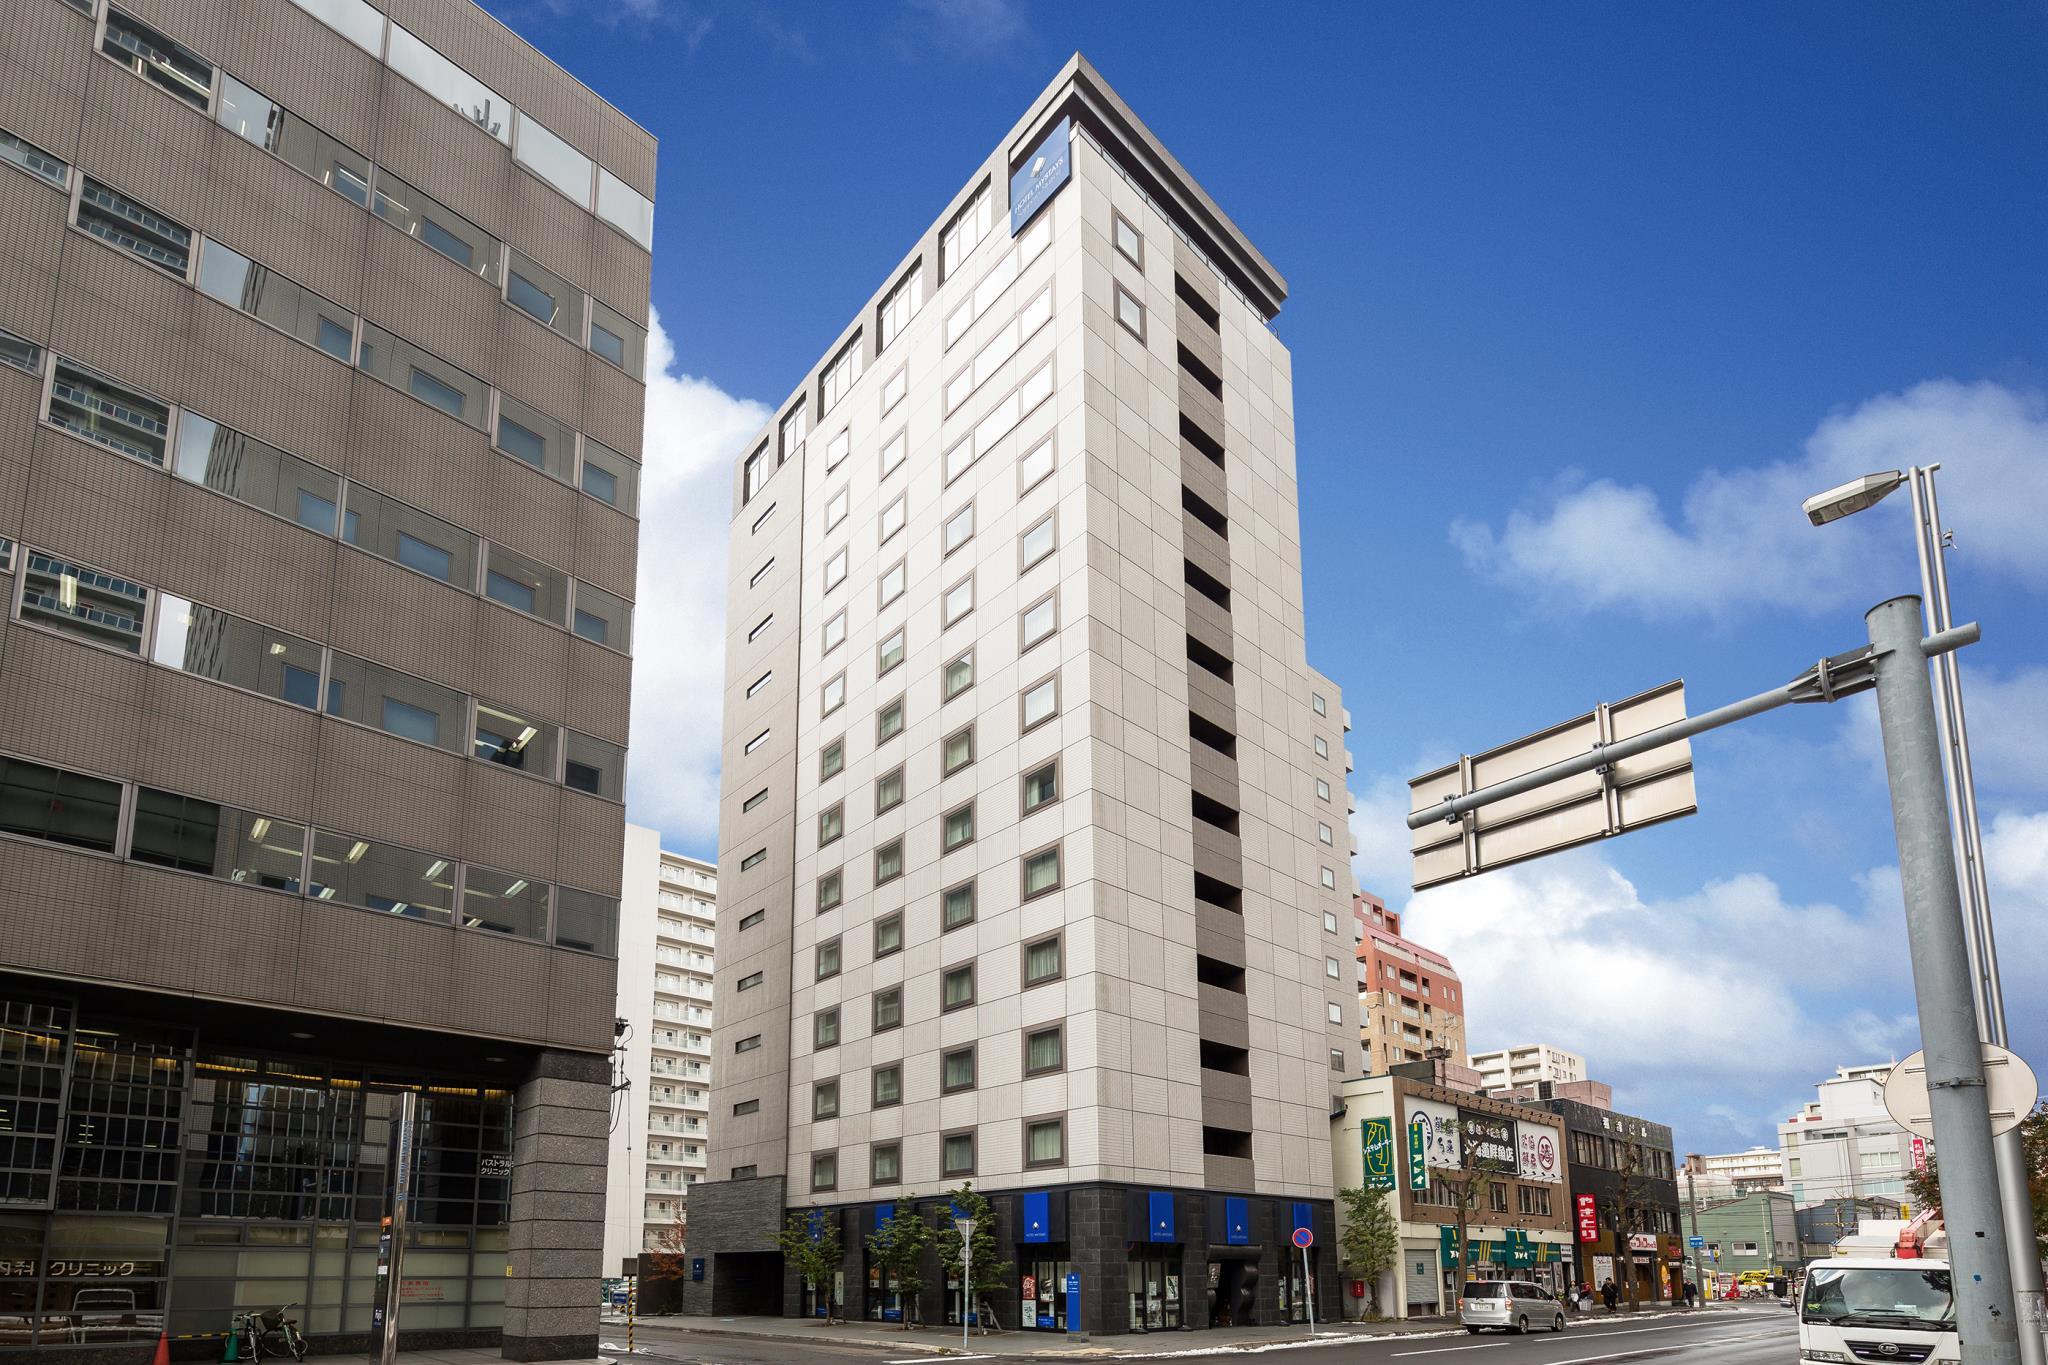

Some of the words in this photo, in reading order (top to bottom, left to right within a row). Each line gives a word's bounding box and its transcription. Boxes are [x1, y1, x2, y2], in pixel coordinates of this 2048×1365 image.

[480, 1167, 510, 1176] クリニック
[50, 1261, 135, 1276] クリニック
